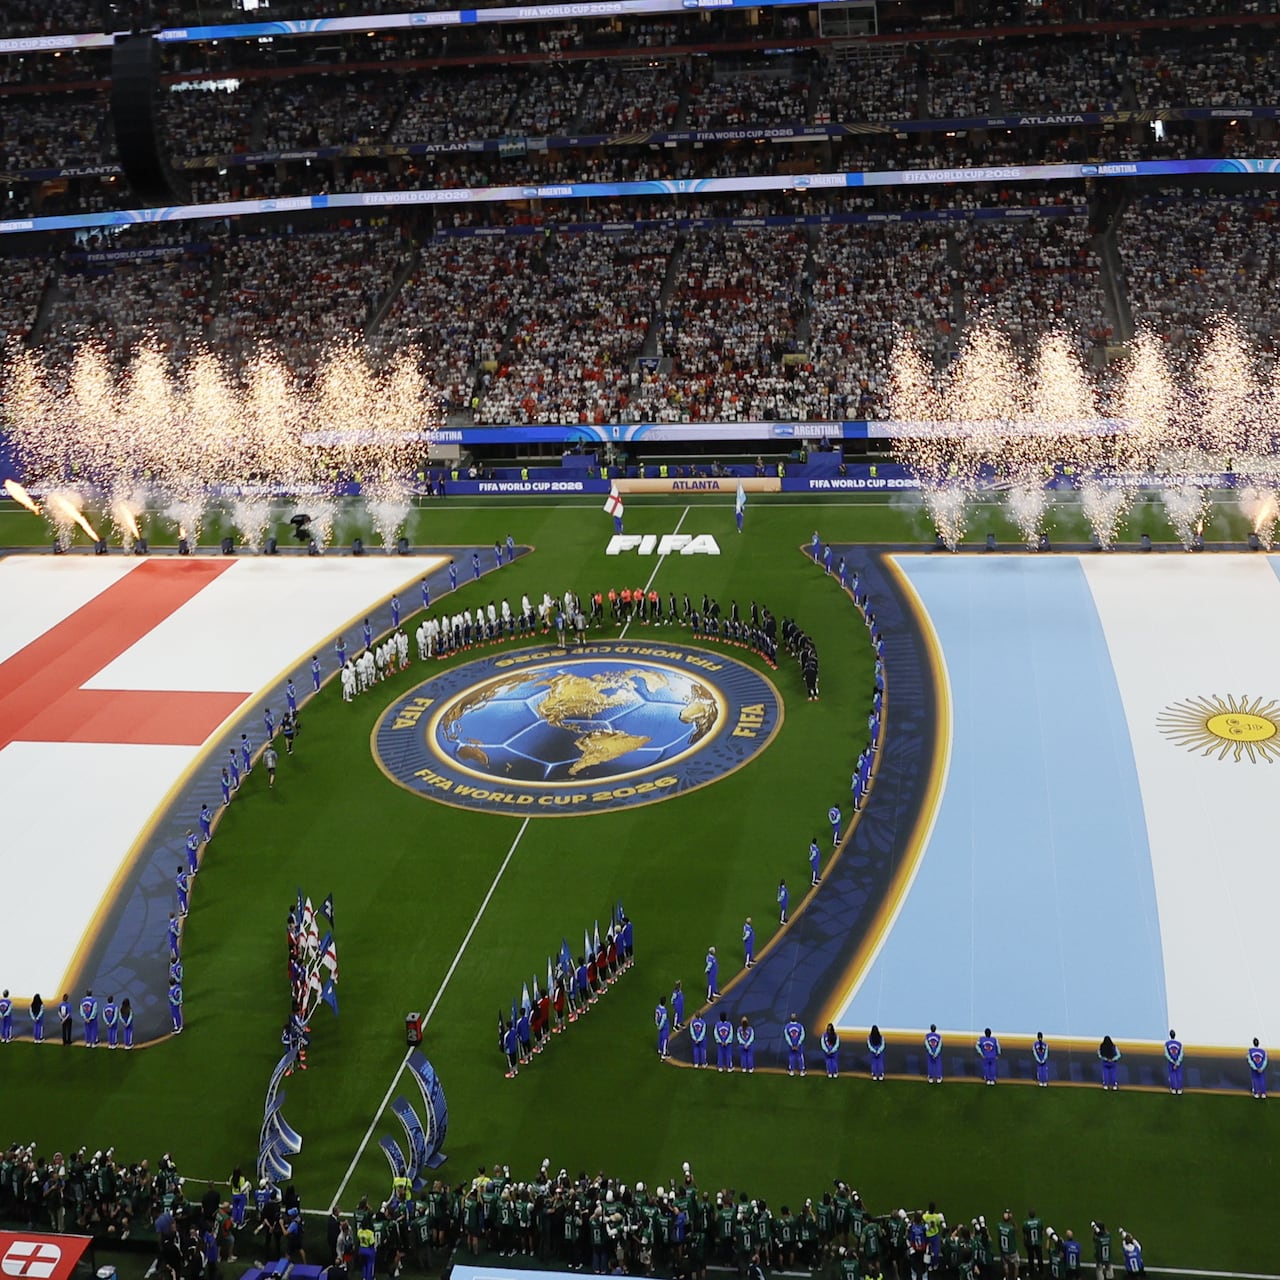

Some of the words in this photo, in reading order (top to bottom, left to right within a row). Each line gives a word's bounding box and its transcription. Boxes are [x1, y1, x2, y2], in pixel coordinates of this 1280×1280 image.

[519, 7, 539, 18] FIFA
[539, 6, 571, 16] WORLD
[571, 5, 589, 14] CUP
[589, 3, 622, 13] 2026
[19, 39, 39, 50] CUP
[39, 36, 73, 48] 2026
[1019, 115, 1084, 125] ATLANTA
[696, 131, 716, 141] FIFA
[716, 130, 746, 140] WORLD
[746, 129, 764, 138] CUP
[764, 128, 794, 137] 2026
[59, 165, 121, 177] ATLANTA
[905, 172, 925, 182] FIFA
[925, 170, 963, 180] WORLD
[963, 169, 984, 179] CUP
[985, 168, 1021, 178] 2026
[1097, 164, 1137, 175] ARGENTINA
[365, 194, 384, 204] FIFA
[384, 193, 418, 203] WORLD
[418, 192, 437, 202] CUP
[437, 190, 470, 200] 2026
[537, 186, 573, 197] ARGENTINA
[87, 254, 106, 263] FIFA
[106, 252, 137, 261] WORLD
[137, 250, 155, 259] CUP
[794, 424, 840, 436] ARGENTINA
[479, 482, 499, 492] FIFA
[499, 482, 532, 492] WORLD
[532, 482, 551, 491] CUP
[551, 482, 583, 491] 2026
[671, 480, 720, 491] ATLANTA
[809, 479, 831, 489] FIFA
[831, 479, 866, 488] WORLD
[866, 479, 887, 488] CUP
[605, 533, 721, 556] FIFA
[624, 646, 694, 664] WORLD
[695, 655, 724, 672] FIFA
[391, 695, 434, 731] FIFA
[731, 702, 767, 739] FIFA
[413, 767, 454, 793] FIFA
[451, 782, 536, 806] WORLD
[537, 792, 588, 806] CUP
[589, 774, 679, 802] 2026
